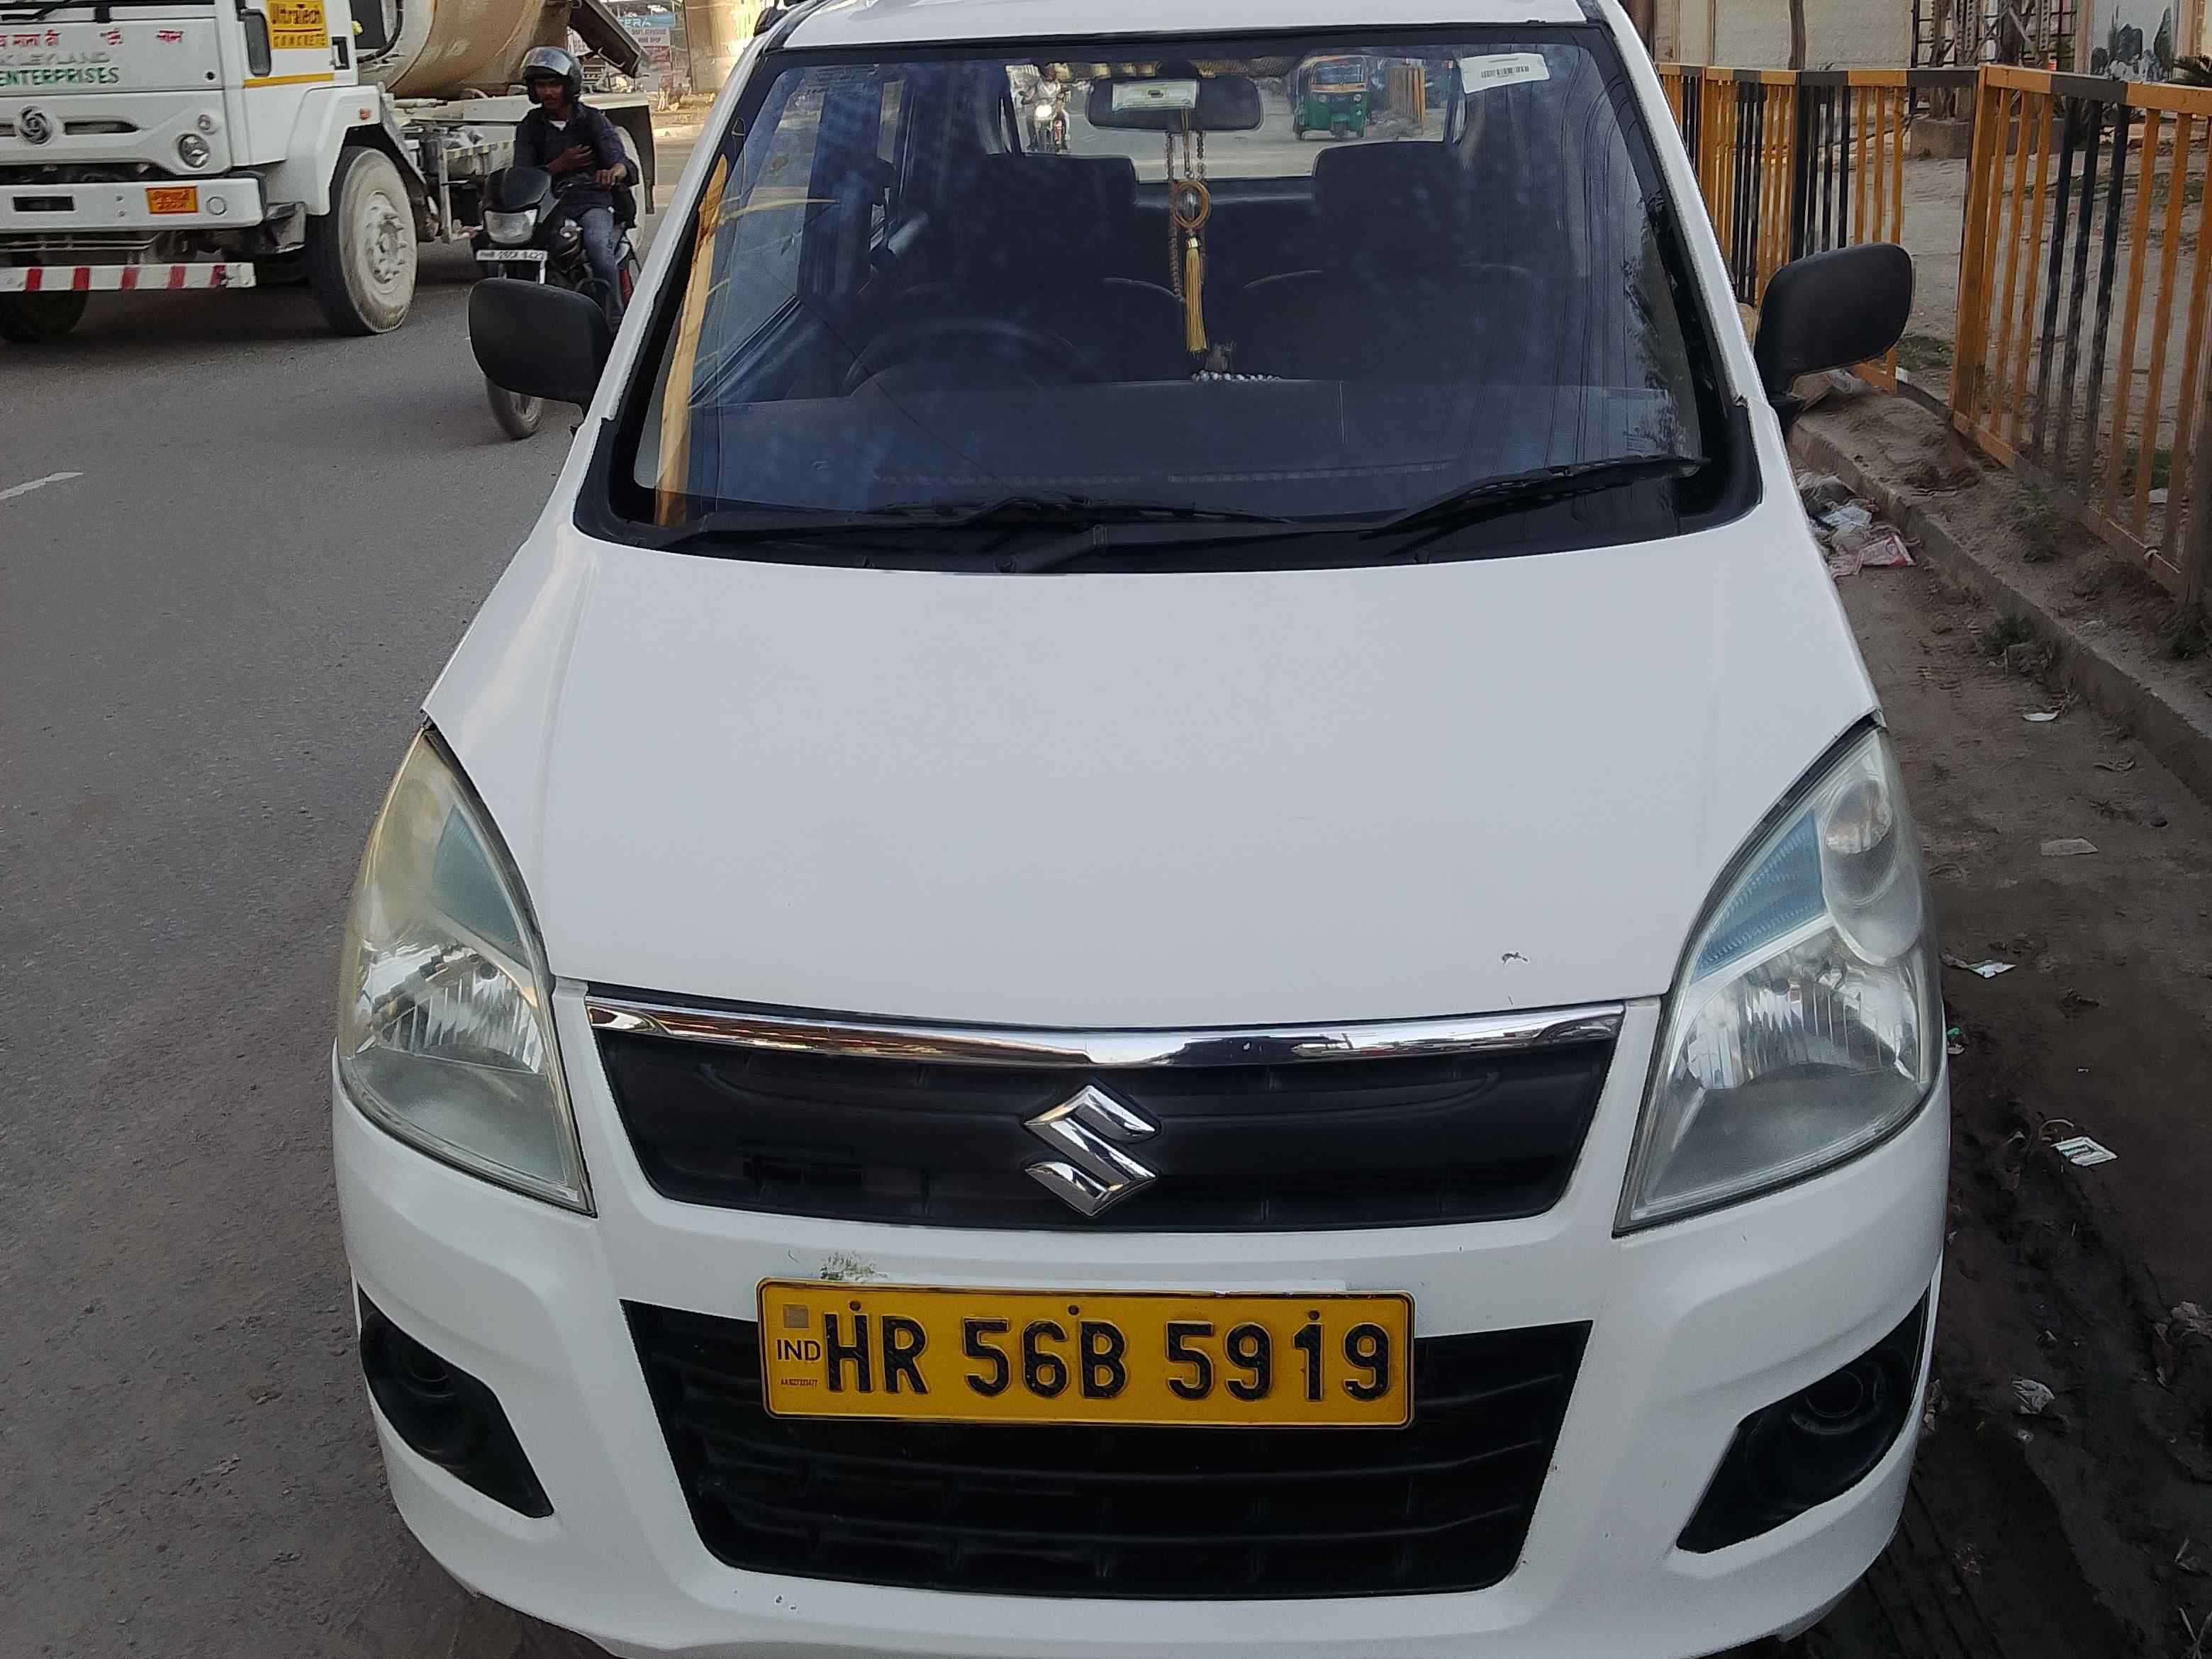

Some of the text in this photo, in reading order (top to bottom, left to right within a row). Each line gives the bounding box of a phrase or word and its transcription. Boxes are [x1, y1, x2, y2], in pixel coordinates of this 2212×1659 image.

[776, 1338, 822, 1362] IND
[824, 1312, 1391, 1401] HR 56B 5919
